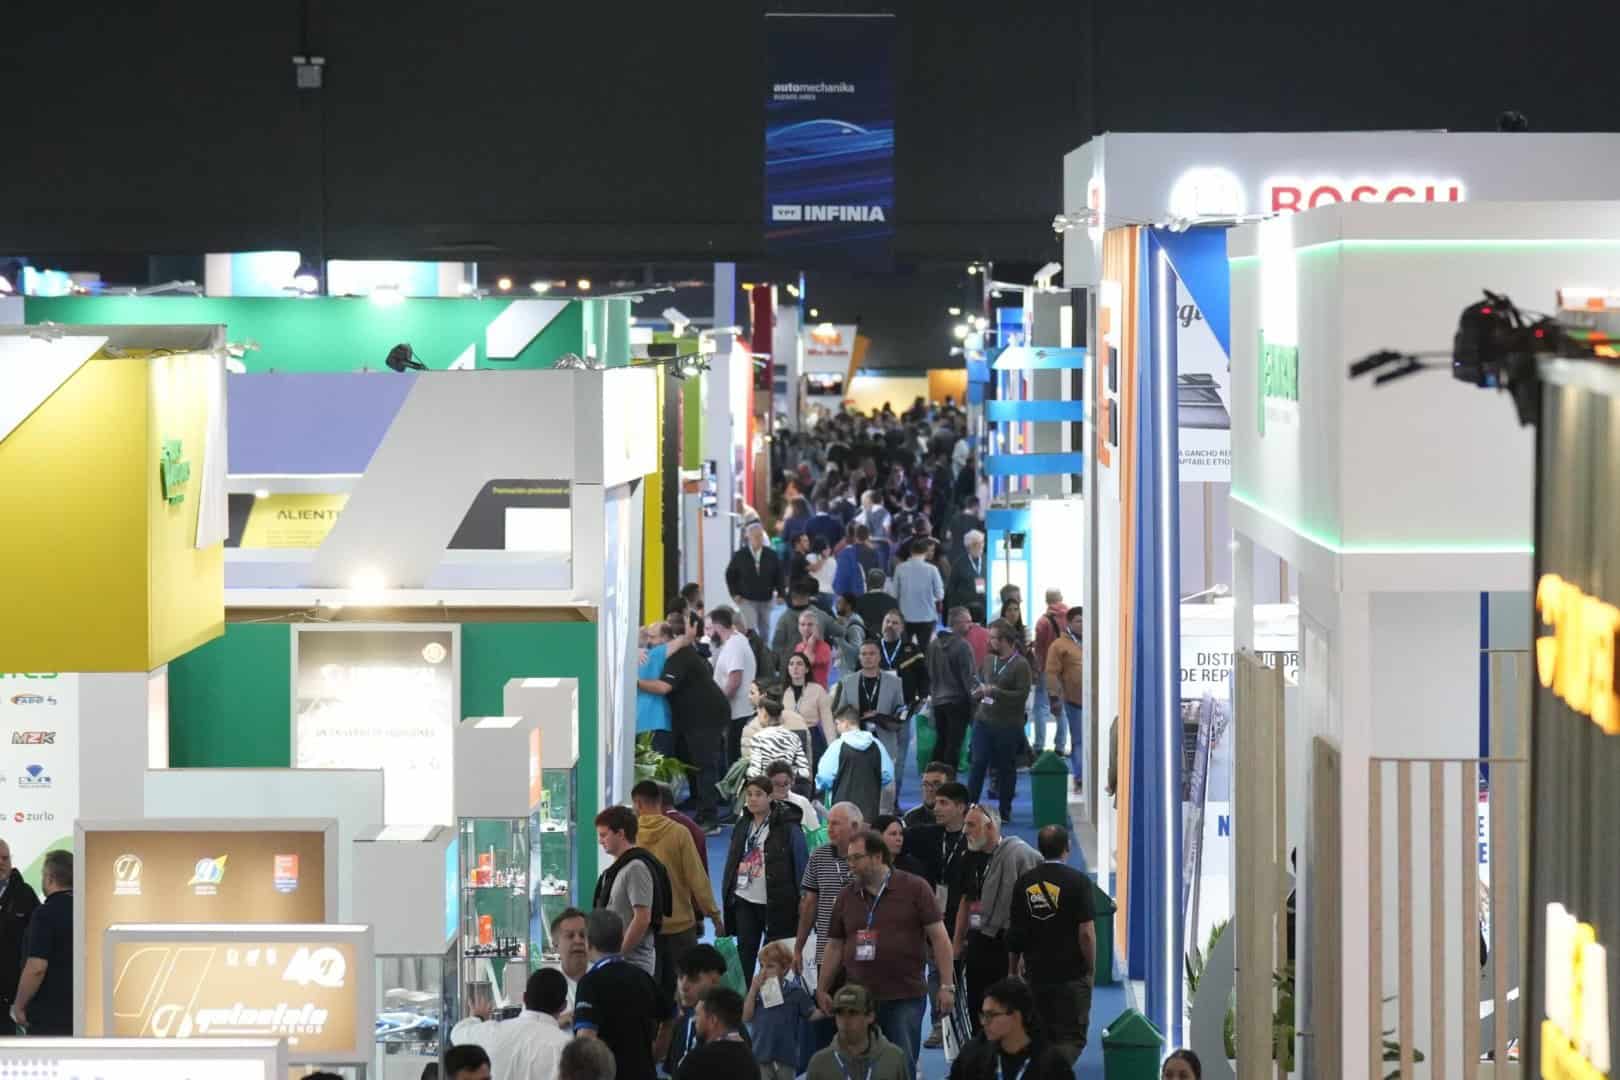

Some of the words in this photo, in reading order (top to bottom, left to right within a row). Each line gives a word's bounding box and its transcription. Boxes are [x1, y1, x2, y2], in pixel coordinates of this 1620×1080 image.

[774, 82, 855, 93] automechanika
[804, 205, 885, 221] INFINIA
[26, 811, 54, 821] zurlo
